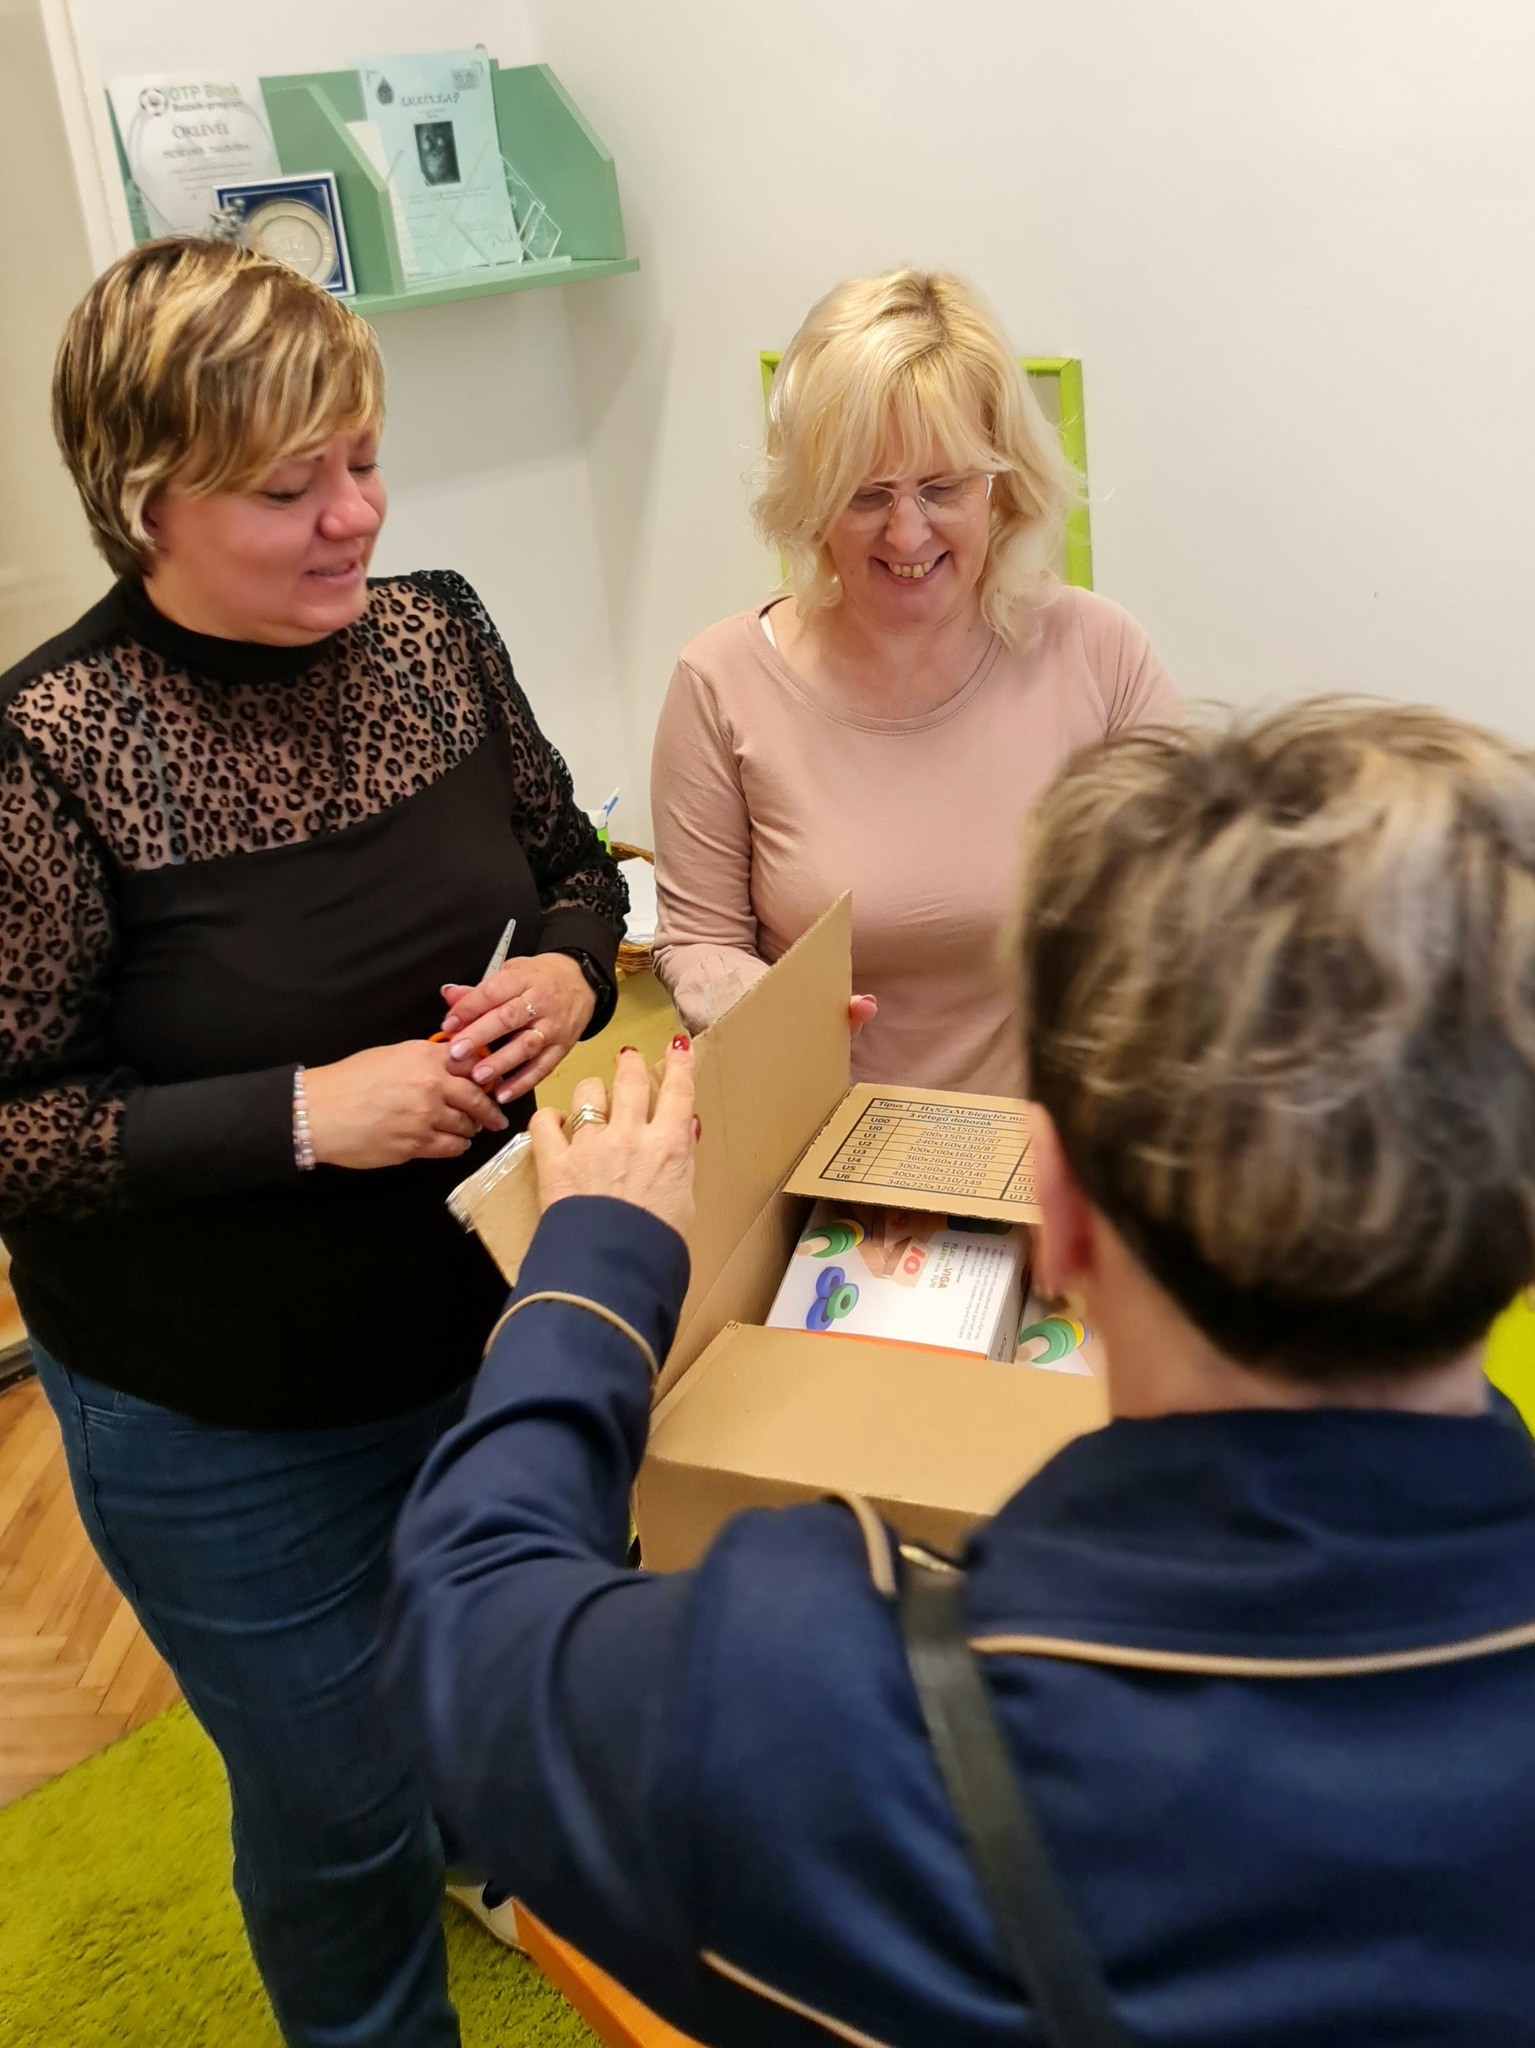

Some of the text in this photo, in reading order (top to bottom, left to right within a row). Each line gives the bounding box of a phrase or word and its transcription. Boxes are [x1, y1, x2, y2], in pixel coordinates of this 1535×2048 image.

[170, 85, 200, 101] OTP
[879, 1101, 903, 1109] Típus
[950, 1116, 992, 1127] dobozok
[939, 1241, 950, 1261] LEARN
[948, 1242, 958, 1258] PLAY
[903, 1246, 926, 1275] 10
[929, 1274, 939, 1288] FUN
[938, 1267, 953, 1289] VIGA
